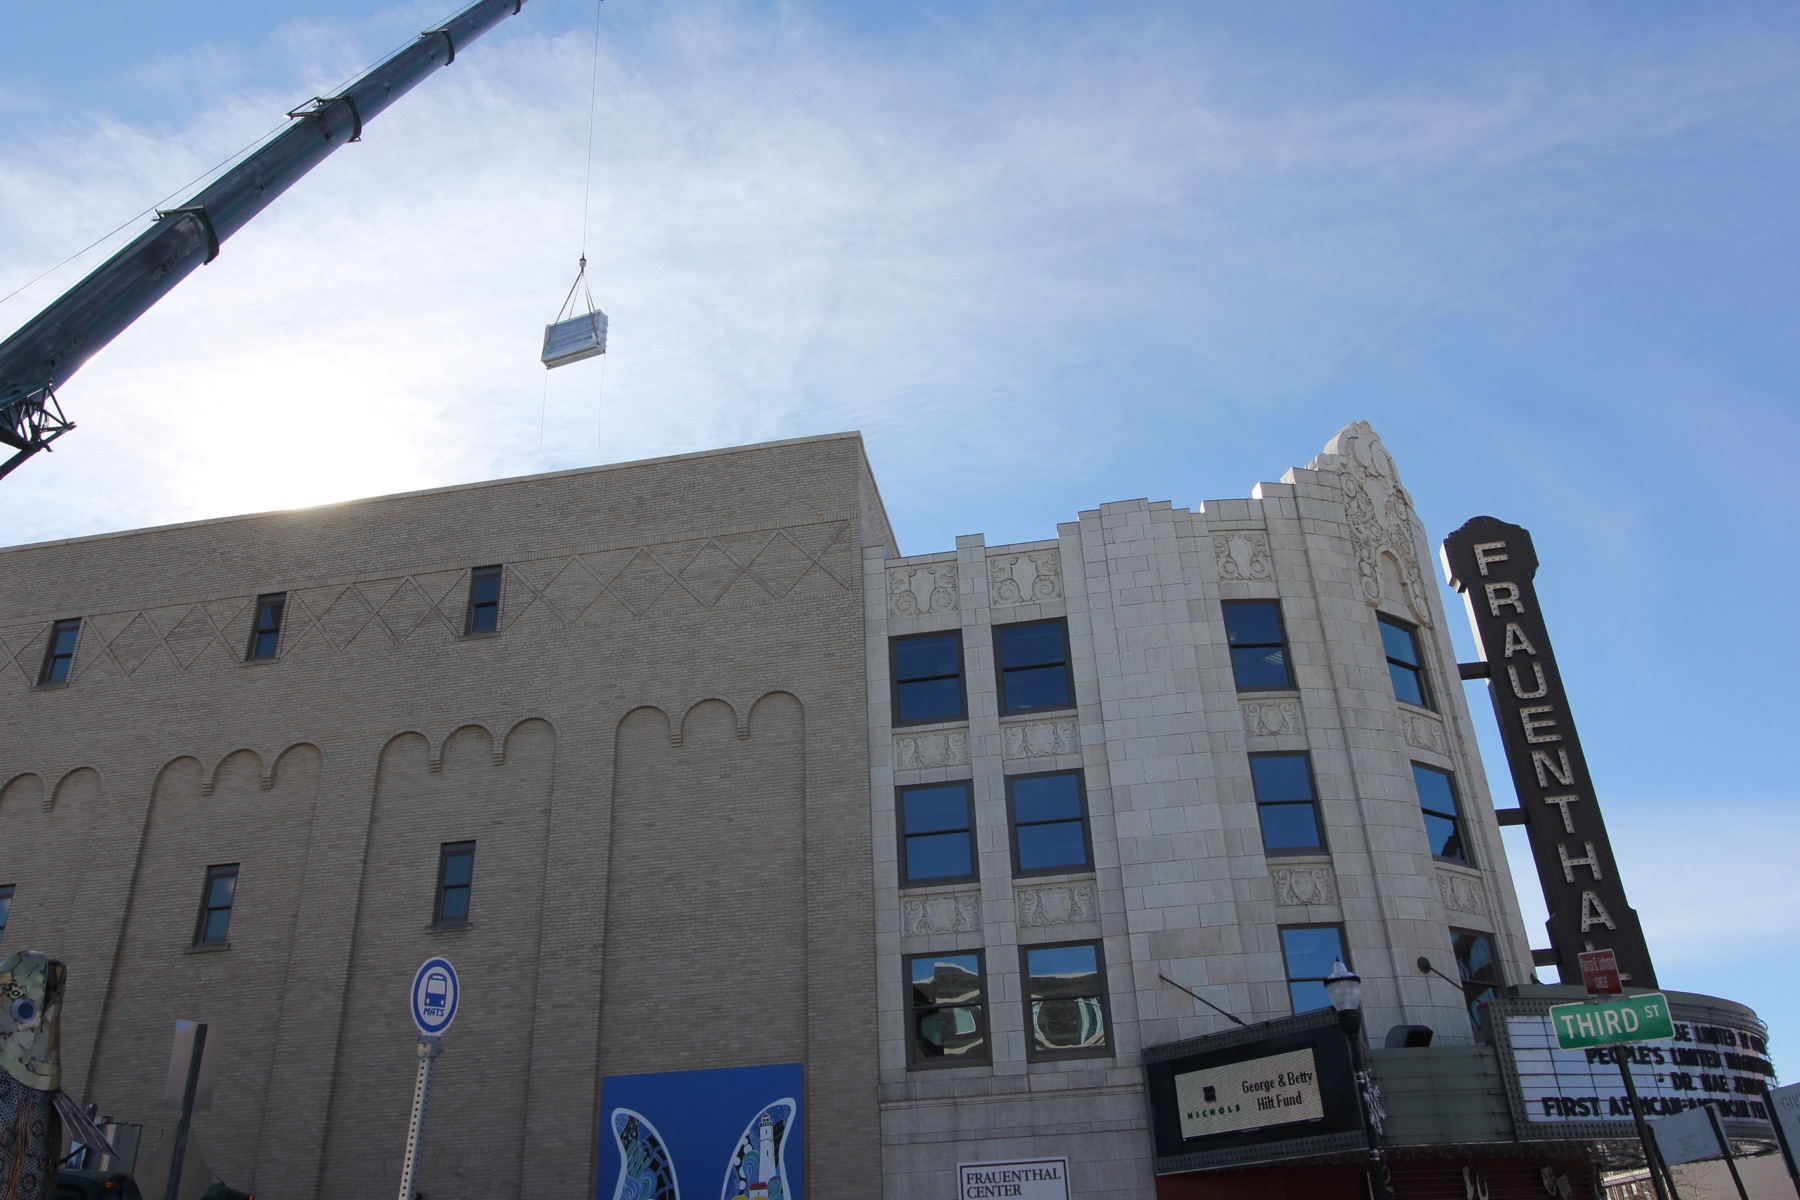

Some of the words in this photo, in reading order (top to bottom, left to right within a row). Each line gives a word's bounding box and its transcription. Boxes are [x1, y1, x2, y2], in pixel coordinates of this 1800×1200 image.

[423, 1007, 445, 1017] MATS
[1560, 1007, 1639, 1039] THIRD
[1644, 1004, 1659, 1018] ST
[1585, 1046, 1665, 1065] PEOPLE'S
[1242, 1079, 1275, 1094] George
[1278, 1073, 1286, 1087] &
[1287, 1070, 1313, 1086] Betty
[1670, 1072, 1698, 1091] DR.
[1276, 1091, 1302, 1109] Fund
[1541, 1096, 1600, 1117] FIRST
[1187, 1104, 1241, 1120] NICHOLS
[966, 1167, 1061, 1185] FRAUENTHAL
[966, 1183, 1023, 1199] CENTER
